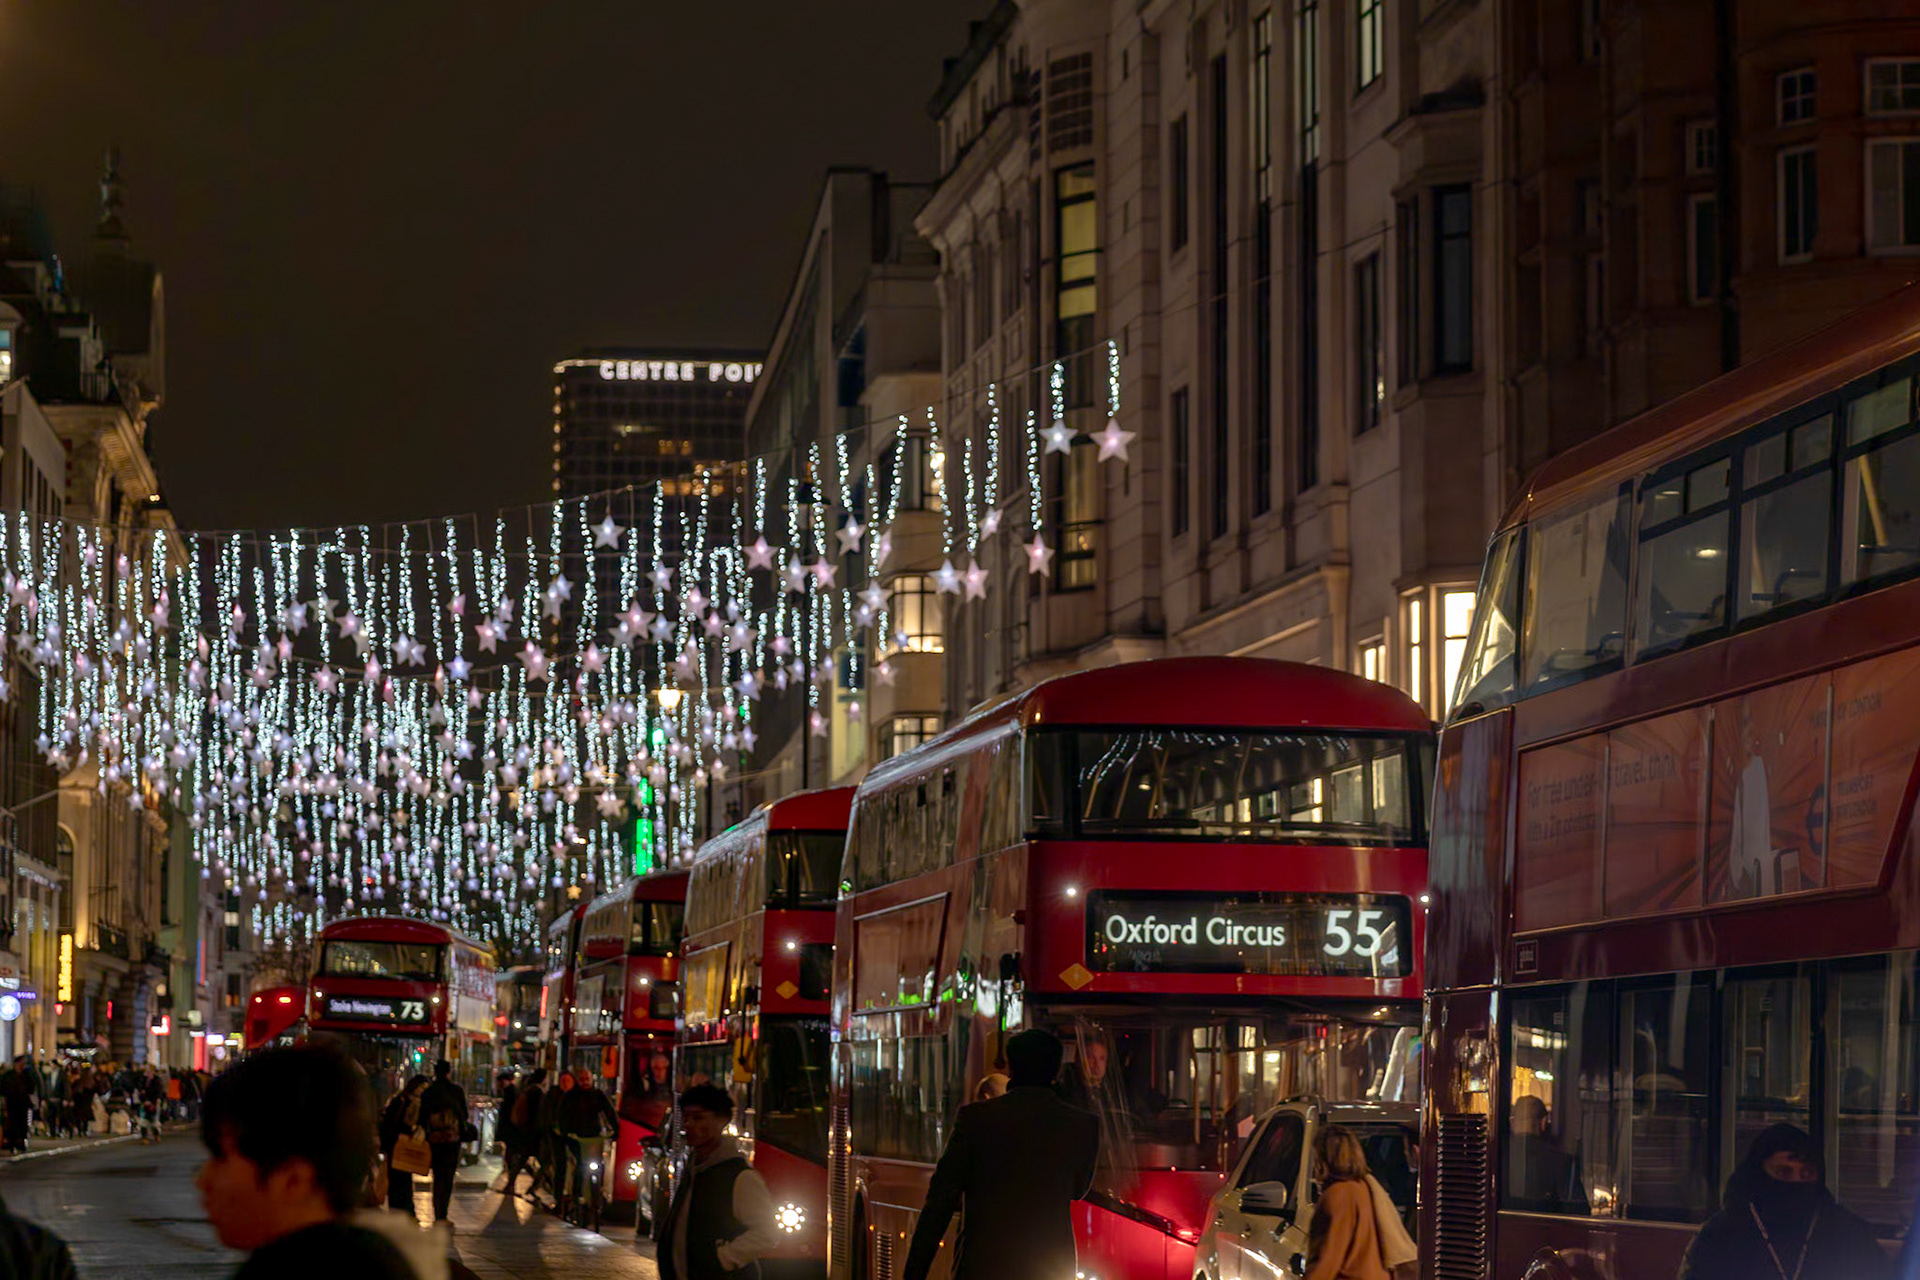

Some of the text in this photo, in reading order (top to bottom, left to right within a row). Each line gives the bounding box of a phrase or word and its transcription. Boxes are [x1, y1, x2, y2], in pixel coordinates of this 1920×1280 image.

[600, 361, 695, 381] CENTRE
[1105, 909, 1384, 957] Oxford Circus 55
[400, 1001, 424, 1020] 73
